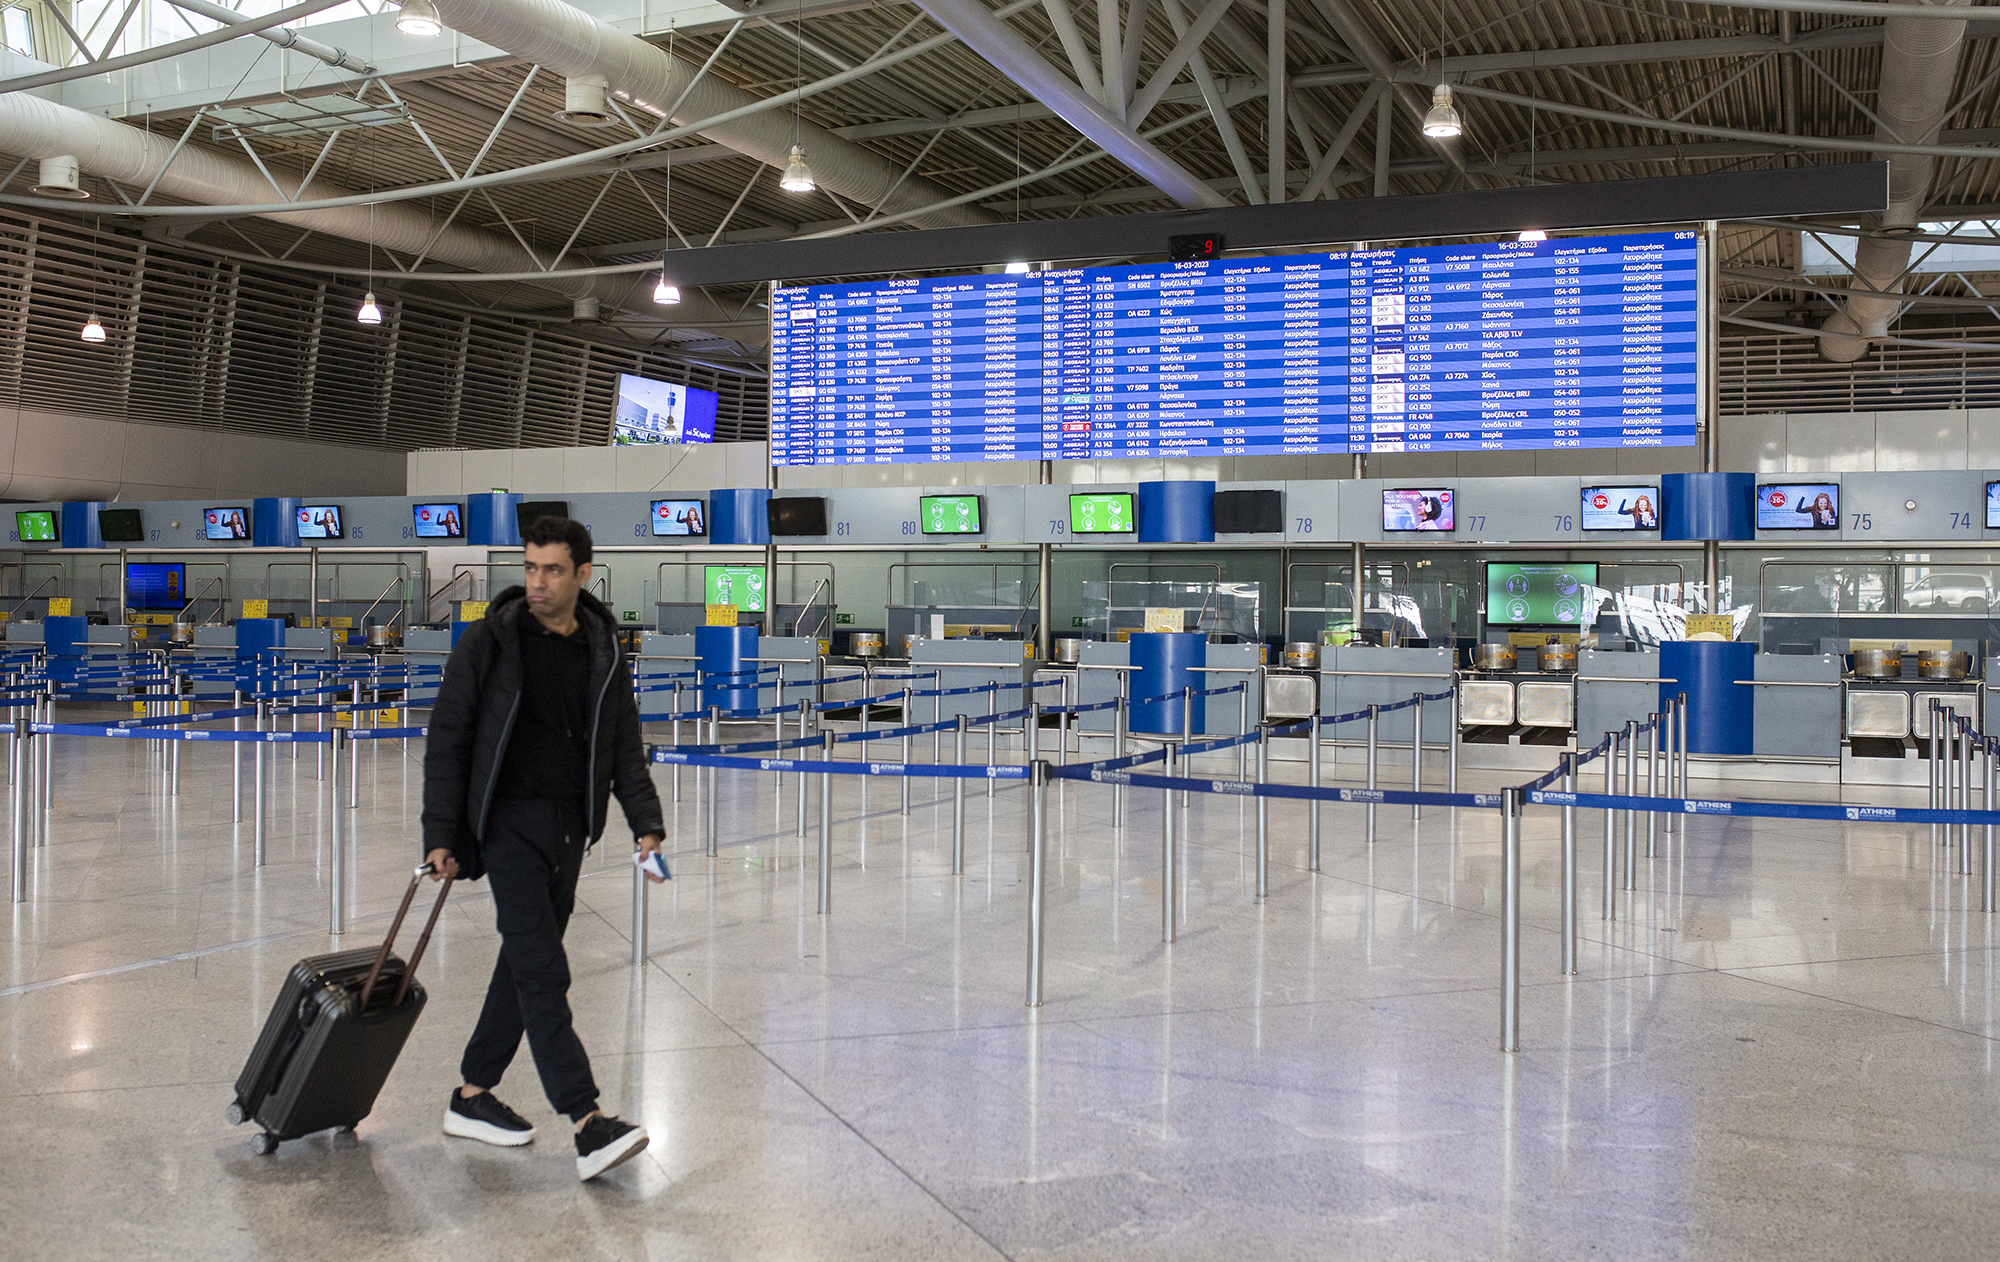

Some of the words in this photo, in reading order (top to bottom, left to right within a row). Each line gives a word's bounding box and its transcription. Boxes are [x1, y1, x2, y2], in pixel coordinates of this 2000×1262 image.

[1205, 241, 1213, 253] 9
[1499, 241, 1537, 249] 16-03-2023
[1351, 250, 1395, 259] Αναχωρήσεις
[1623, 253, 1662, 262] Ακυρώθηκε
[1175, 261, 1209, 269] 16-03-2023
[1623, 263, 1663, 272] Ακυρώθηκε
[1044, 270, 1084, 278] Αναχωρήσεις
[1623, 273, 1662, 282] Ακυρώθηκε
[1623, 284, 1662, 292] Ακυρώθηκε
[1623, 325, 1662, 333] Ακυρώθηκε
[1296, 518, 1312, 533] 78
[1468, 516, 1486, 531] 77
[1554, 516, 1572, 531] 76
[1852, 514, 1872, 531] 75
[1950, 512, 1971, 530] 74
[402, 526, 413, 539] 84
[634, 524, 646, 537] 82
[837, 522, 850, 535] 81
[902, 521, 916, 535] 80
[1050, 520, 1064, 534] 79
[9, 531, 19, 542] 88
[151, 530, 160, 541] 87
[196, 529, 206, 540] 86
[352, 527, 363, 539] 85
[1224, 782, 1254, 790] ATHENS
[1697, 801, 1732, 809] ATHENS
